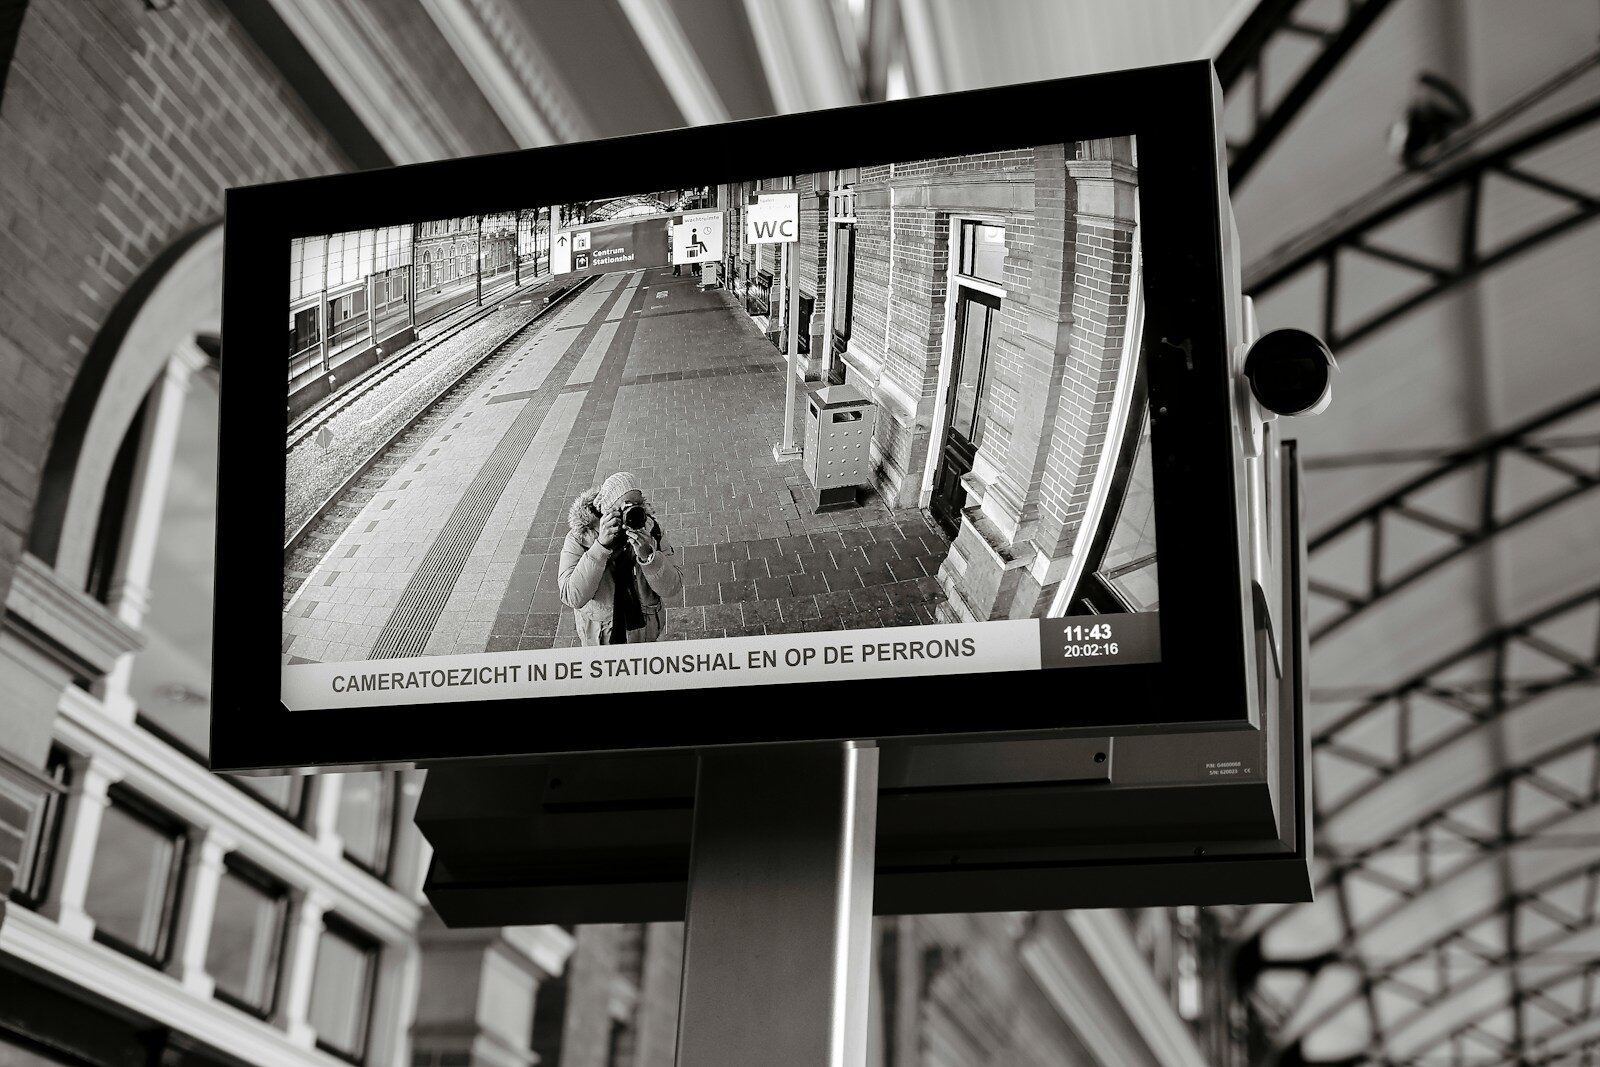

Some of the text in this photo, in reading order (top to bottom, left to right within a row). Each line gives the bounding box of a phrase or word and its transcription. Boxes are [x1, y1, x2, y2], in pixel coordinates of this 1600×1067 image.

[753, 219, 793, 239] WC
[592, 247, 625, 257] Centrum
[592, 253, 635, 266] Stationshal
[1063, 623, 1112, 641] 11:43
[1064, 642, 1119, 658] 20:02:16
[331, 637, 976, 693] CAMERATOEZICHT IN DE STATIONSHAL EN OP DE PERRONS
